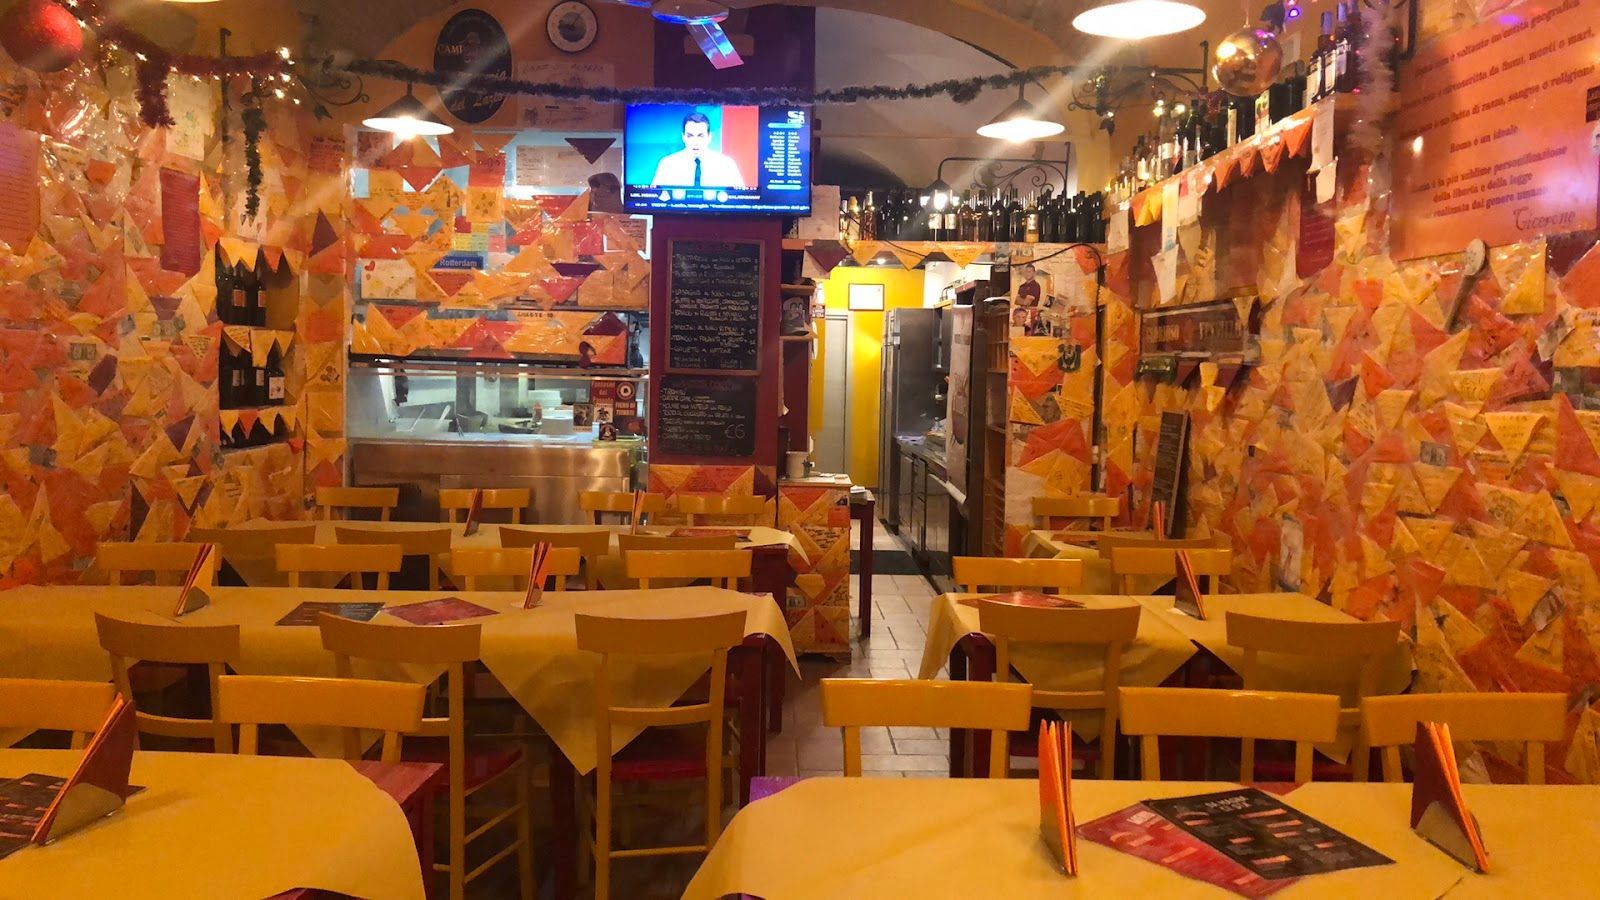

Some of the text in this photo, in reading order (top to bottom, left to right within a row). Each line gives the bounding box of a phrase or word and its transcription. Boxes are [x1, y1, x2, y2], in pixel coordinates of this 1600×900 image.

[1489, 65, 1499, 76] da
[1529, 40, 1556, 60] monti
[1559, 40, 1565, 49] o
[1472, 104, 1480, 115] di
[1508, 84, 1540, 102] sangue
[1542, 81, 1548, 90] o
[1551, 65, 1595, 86] religione
[1450, 142, 1472, 154] Roma
[1480, 134, 1491, 145] un
[1493, 125, 1519, 140] ideale
[1461, 166, 1492, 181] sublime
[1494, 146, 1568, 175] personificazione
[1433, 191, 1451, 203] della
[1480, 184, 1486, 192] e
[1487, 177, 1507, 190] della
[1510, 173, 1533, 186] legge
[1486, 193, 1515, 209] genere
[724, 423, 747, 440] €6
